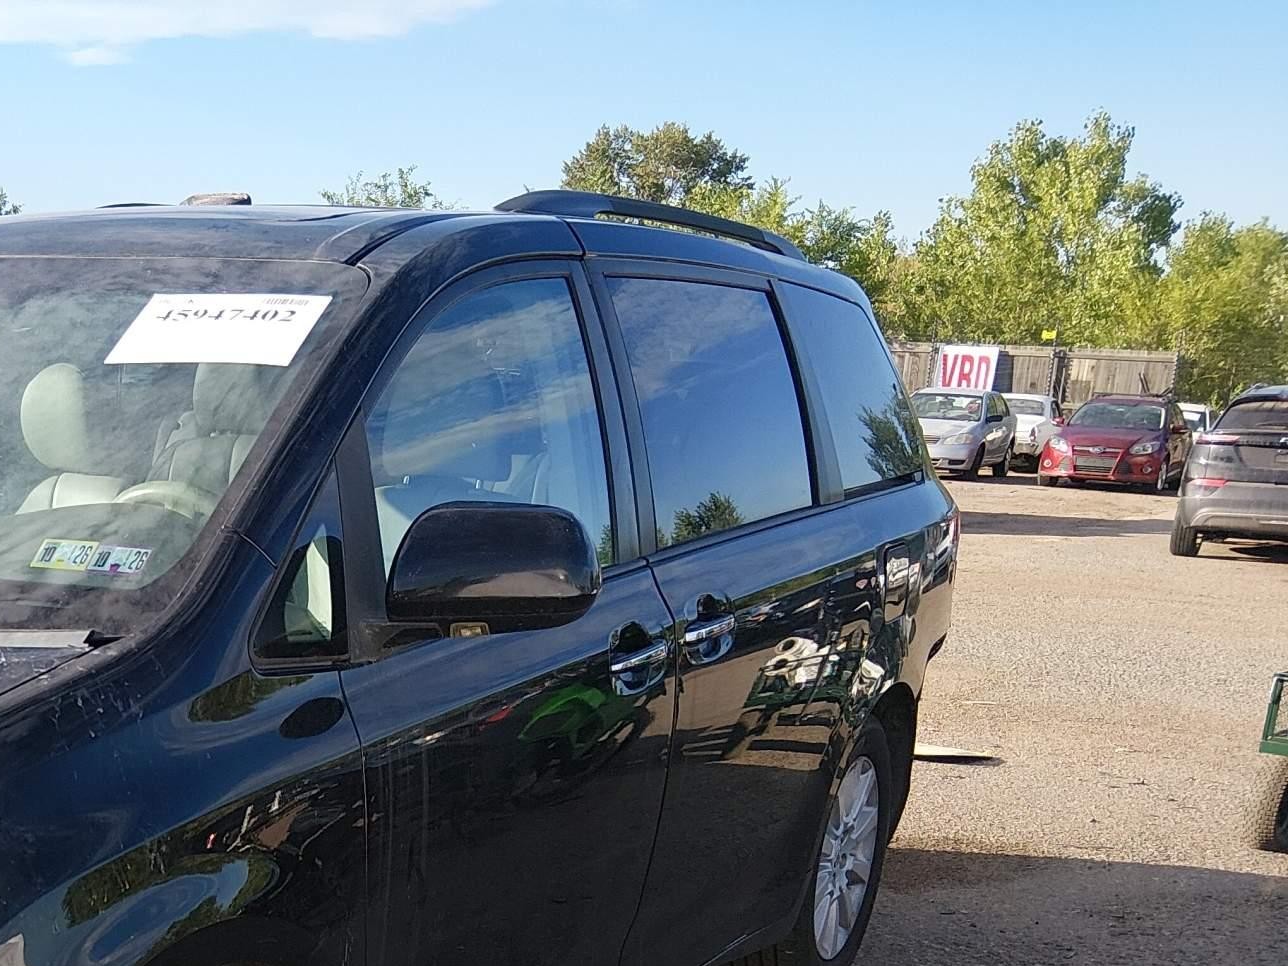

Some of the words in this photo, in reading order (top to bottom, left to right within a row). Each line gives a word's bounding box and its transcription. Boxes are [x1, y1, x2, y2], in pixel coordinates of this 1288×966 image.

[156, 309, 296, 322] 45947402
[73, 545, 92, 564] 26
[128, 550, 148, 570] 26
